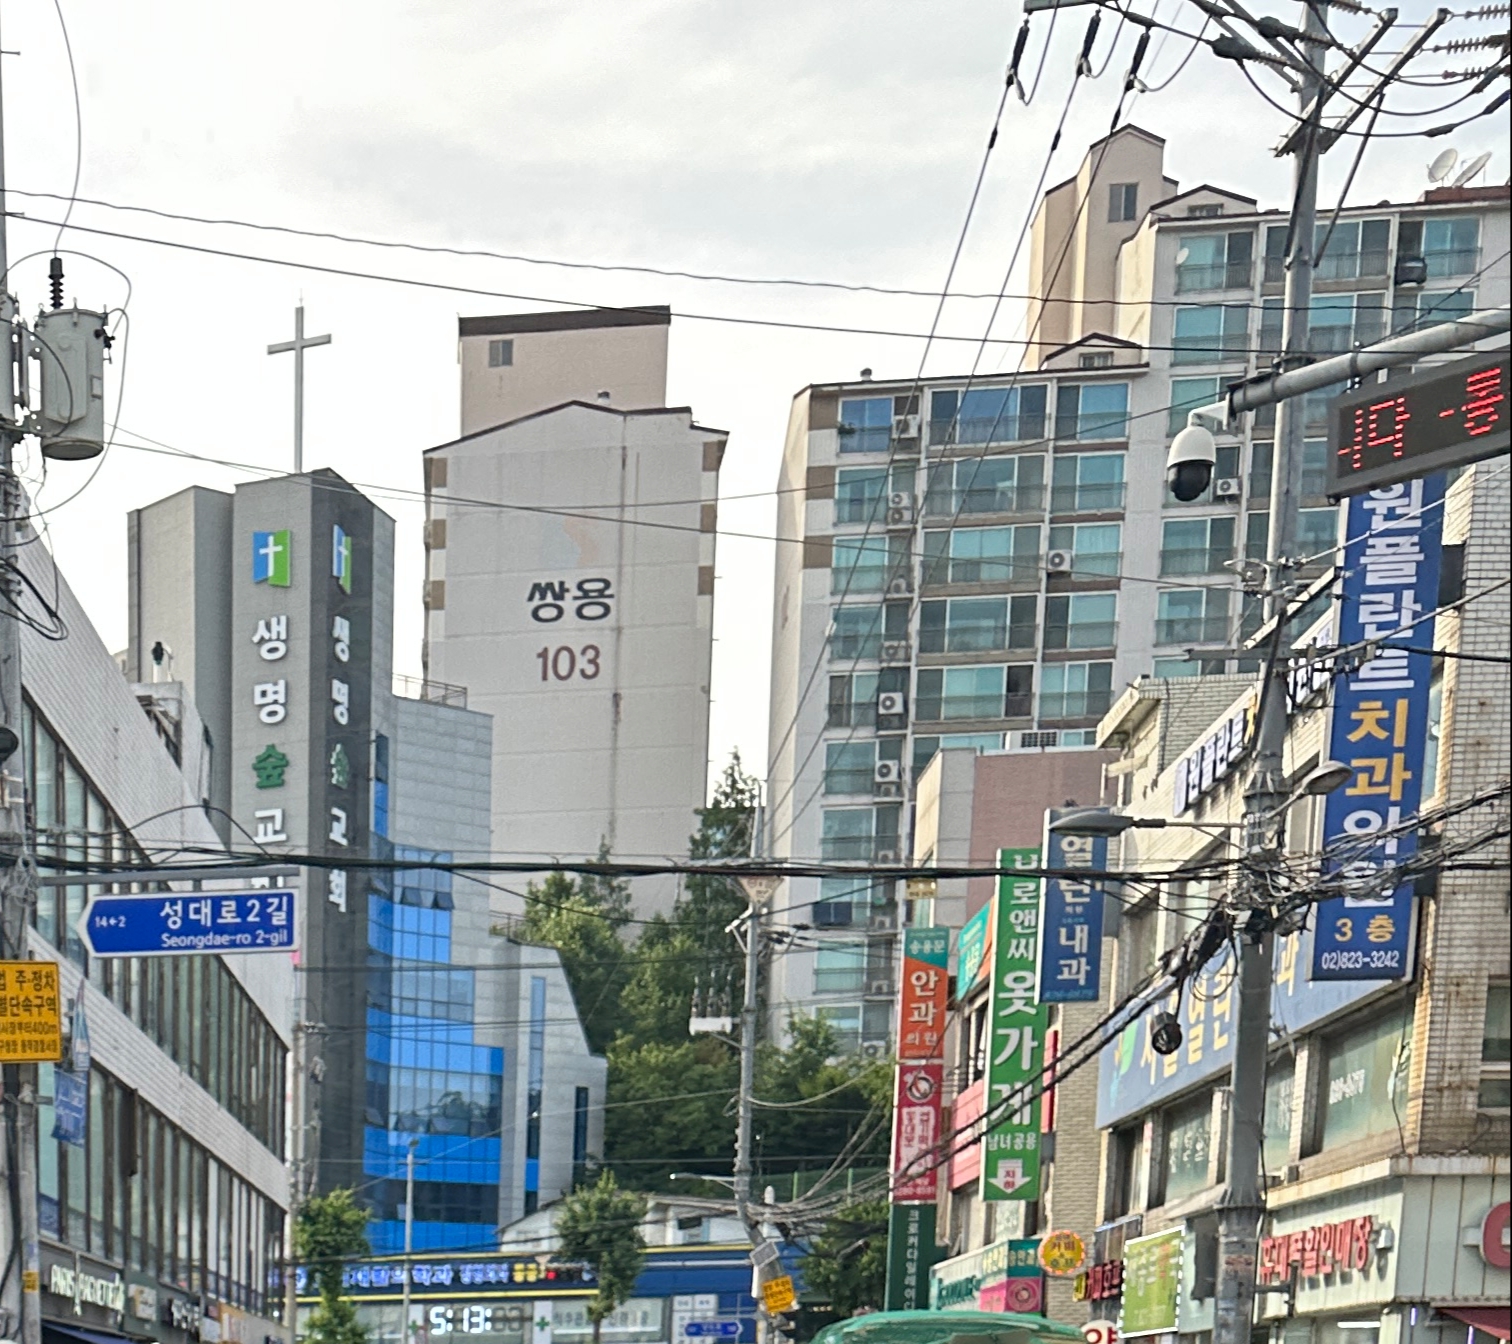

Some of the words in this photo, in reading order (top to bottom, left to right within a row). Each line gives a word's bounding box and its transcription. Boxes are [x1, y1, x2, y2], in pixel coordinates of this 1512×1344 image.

[526, 576, 615, 623] 쌍용
[535, 645, 602, 681] 103
[252, 615, 289, 889] 생명숲교
[160, 896, 287, 930] 성대로2길
[161, 932, 252, 949] Seongdae-ro
[256, 929, 288, 947] 2-gil
[1057, 924, 1091, 986] 내과
[1321, 950, 1400, 971] 02)823-3242
[908, 968, 939, 1026] 안과
[990, 970, 1039, 1125] 옷가게
[988, 1133, 1037, 1151] 남녀공용
